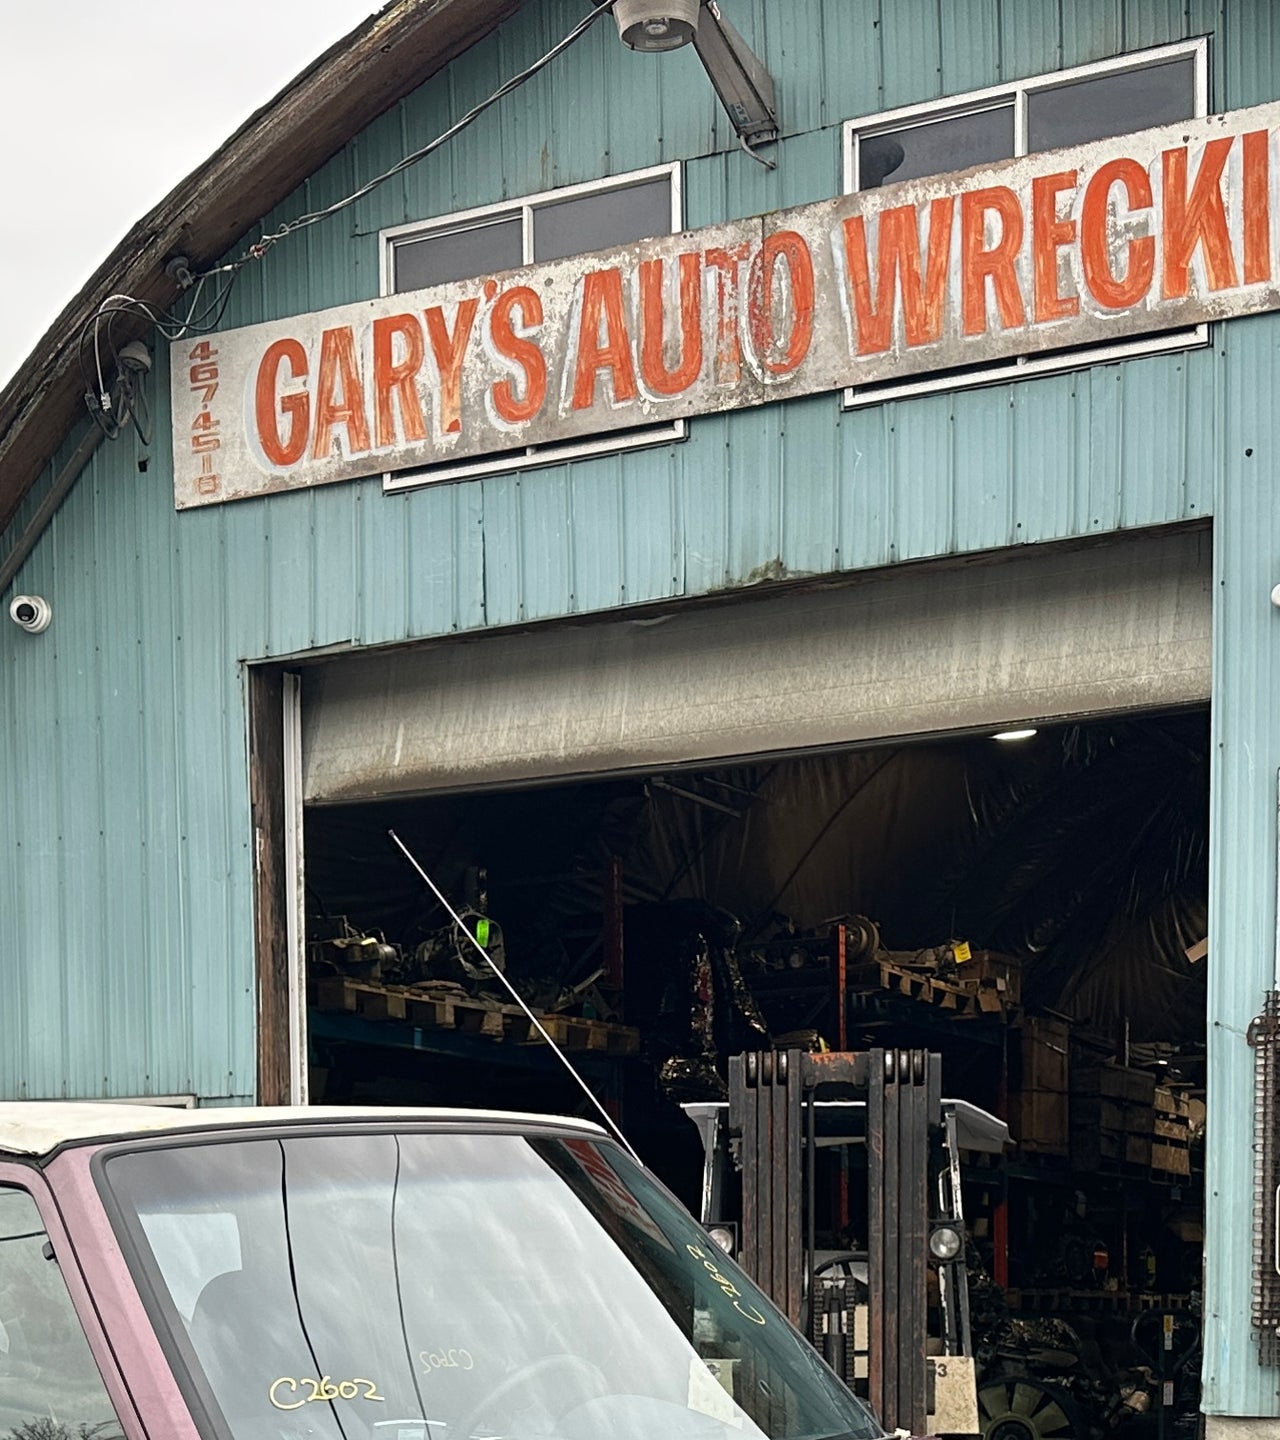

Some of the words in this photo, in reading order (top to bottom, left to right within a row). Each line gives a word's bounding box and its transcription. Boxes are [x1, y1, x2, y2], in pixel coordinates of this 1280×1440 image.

[252, 279, 546, 467] GARY'S
[570, 240, 814, 412] AUTO
[270, 1376, 385, 1410] C2602
